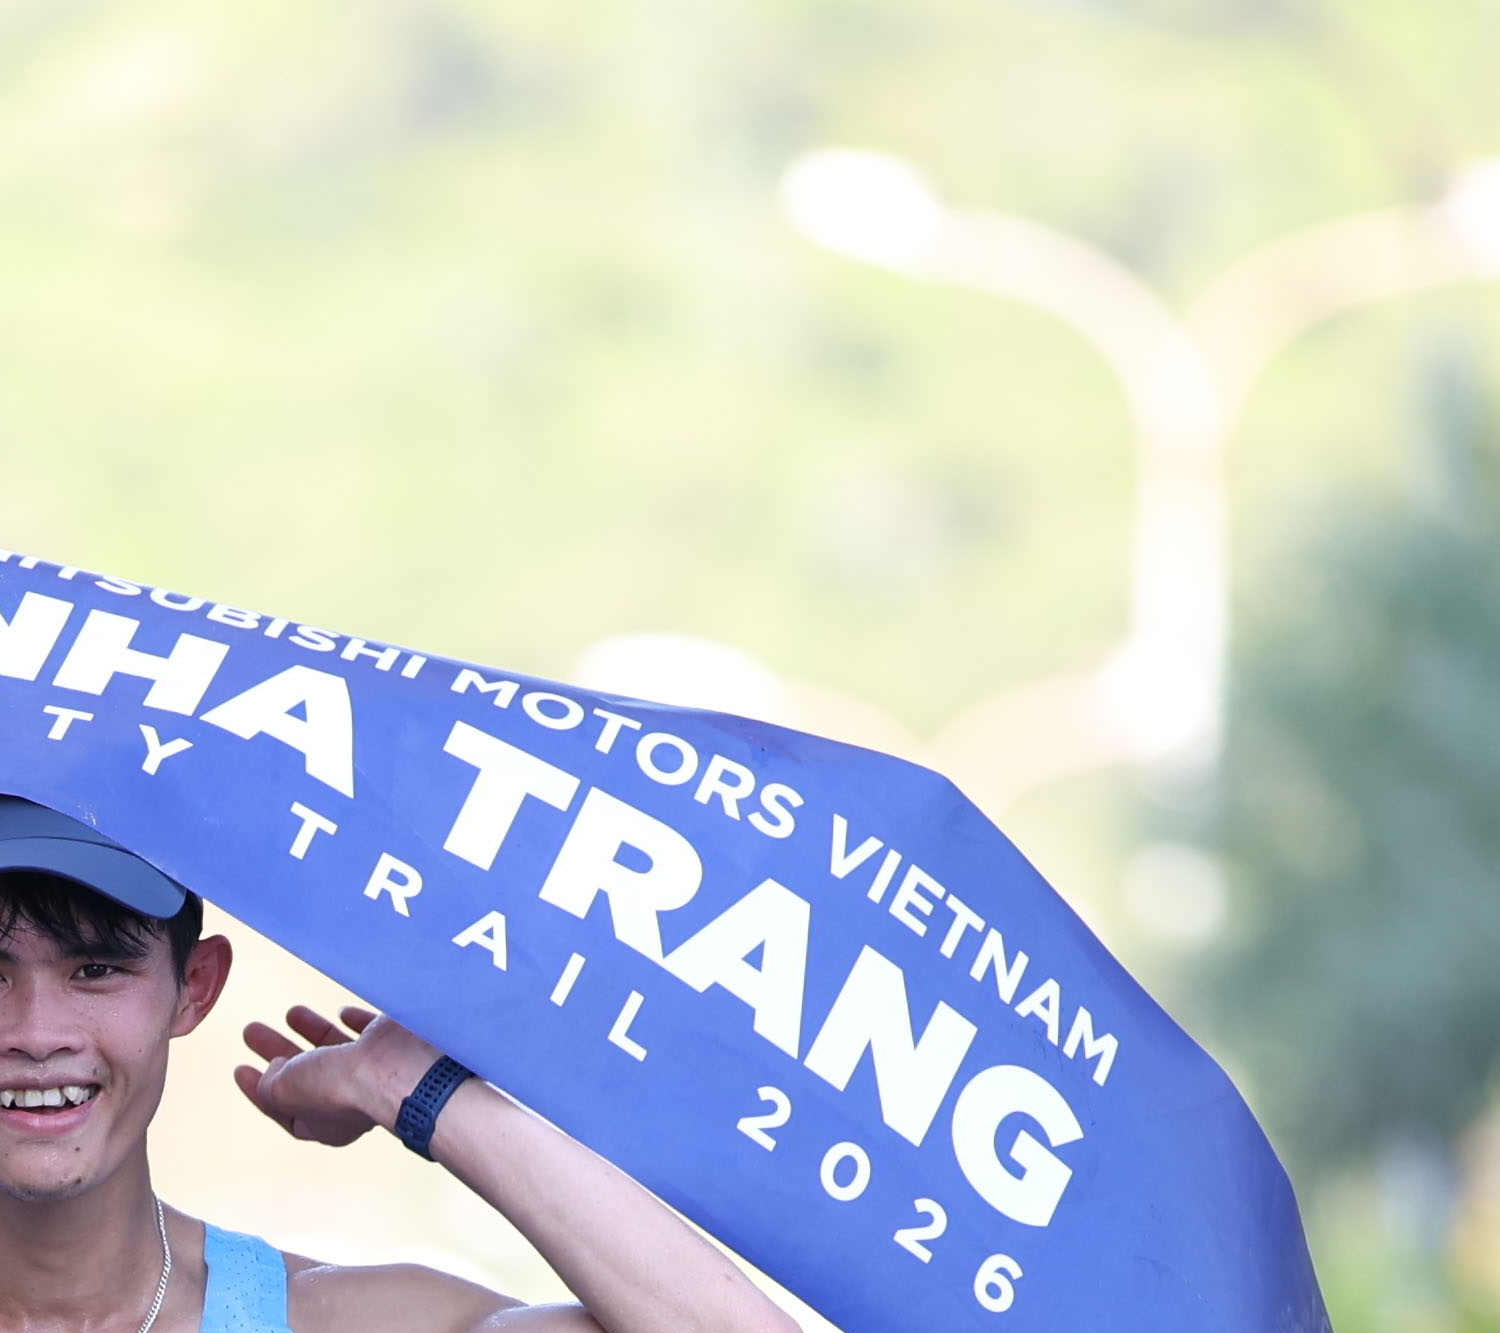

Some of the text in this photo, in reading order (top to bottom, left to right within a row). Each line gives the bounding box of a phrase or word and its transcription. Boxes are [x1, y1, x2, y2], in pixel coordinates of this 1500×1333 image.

[289, 801, 647, 1062] TRAIL
[736, 1085, 1023, 1313] 2026
[442, 720, 1084, 1227] TRANG
[450, 668, 805, 839] MOTORS
[831, 813, 1119, 1086] VIETNAM
